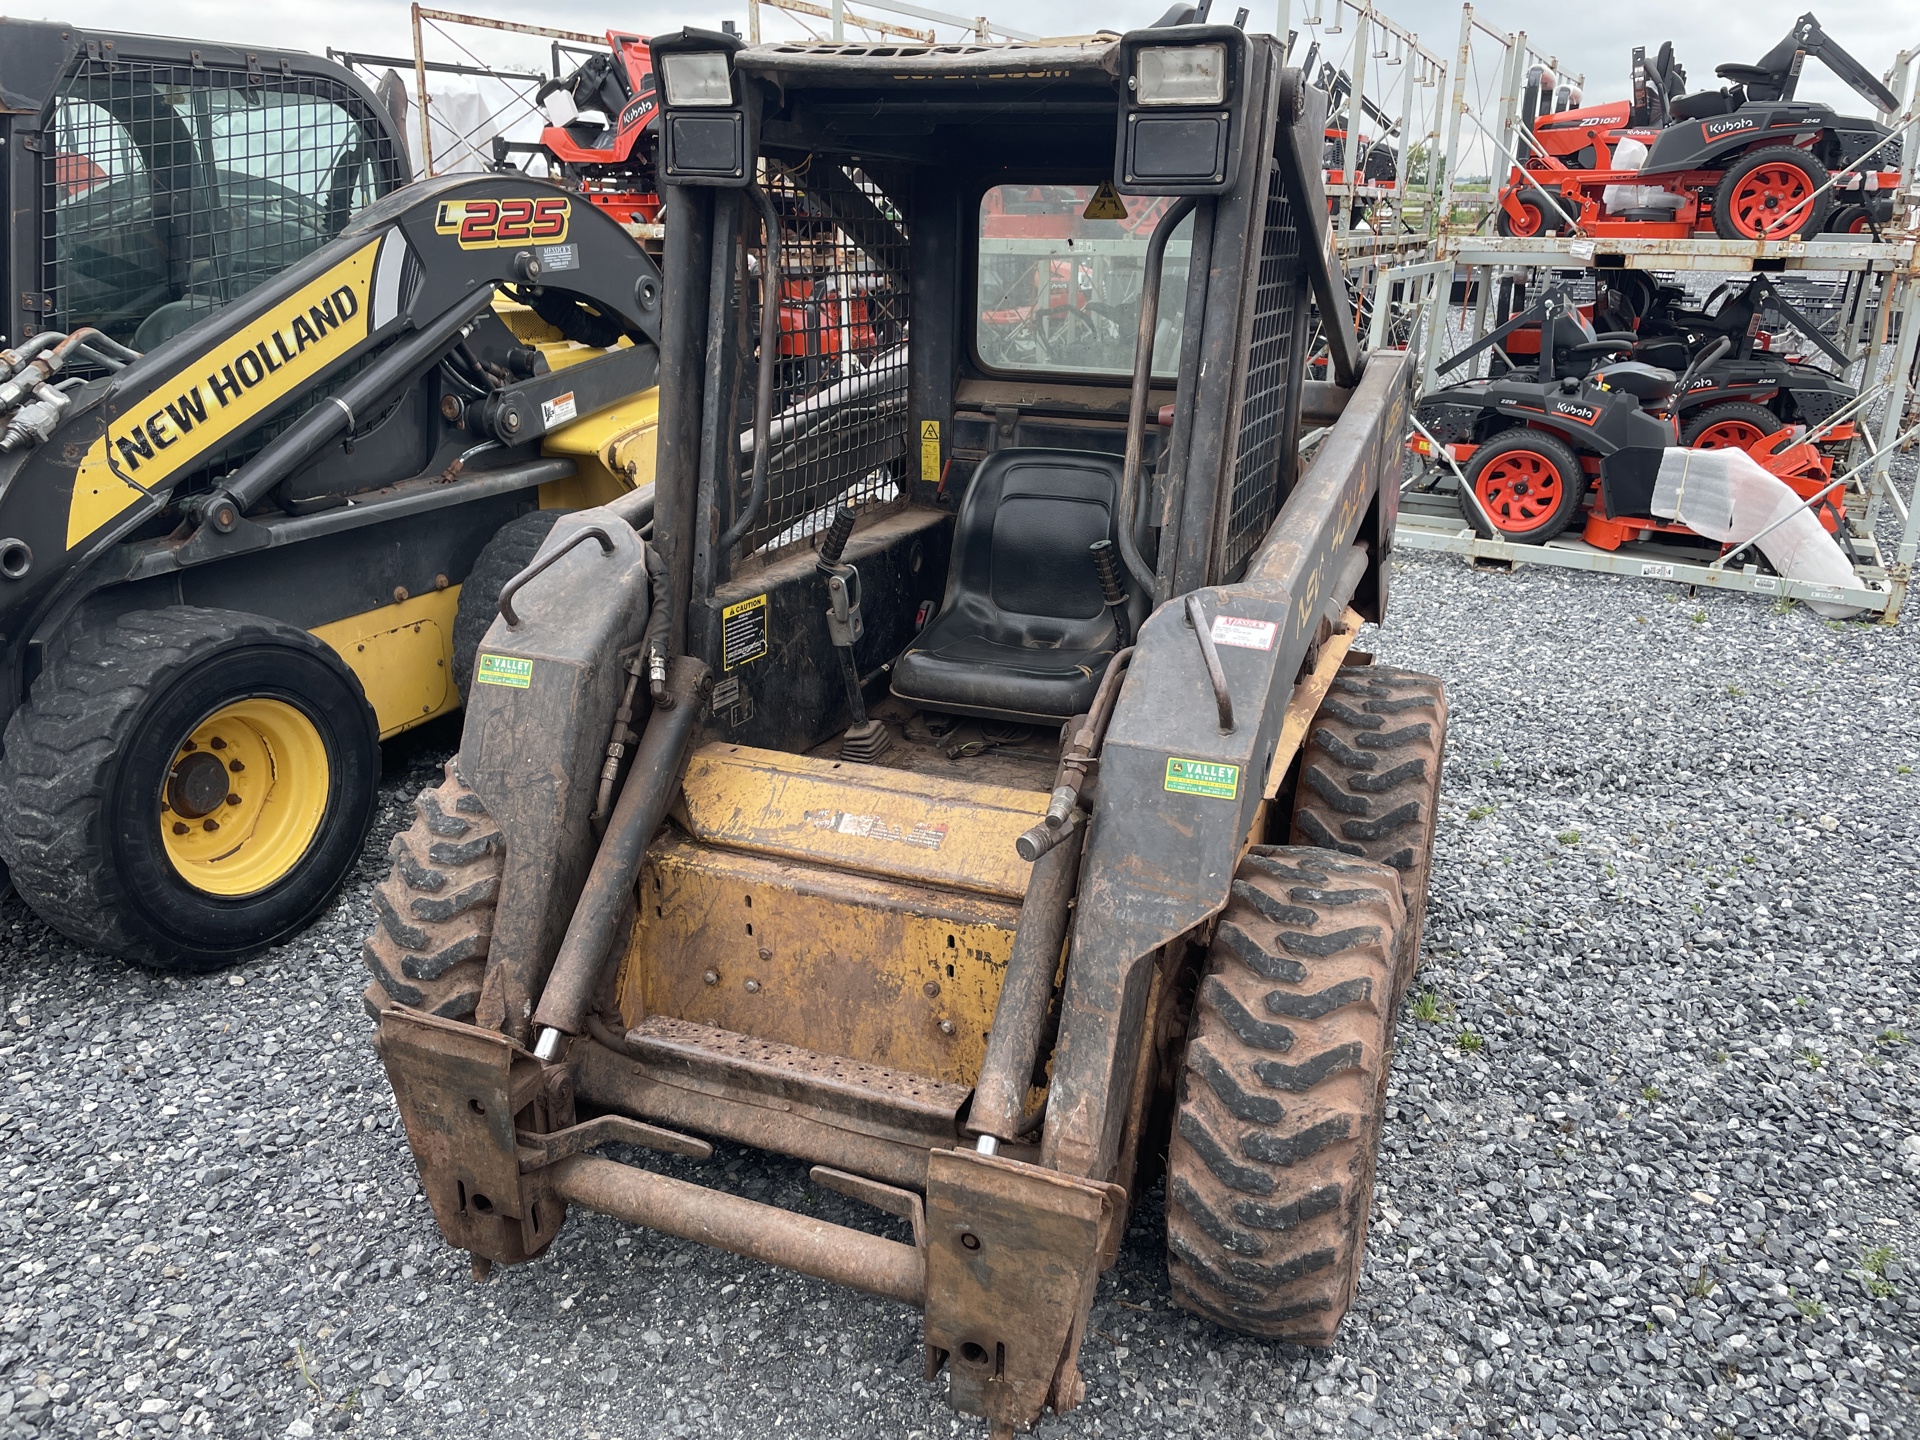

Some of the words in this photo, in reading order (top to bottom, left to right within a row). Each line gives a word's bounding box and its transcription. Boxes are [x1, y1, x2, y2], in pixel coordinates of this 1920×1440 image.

[623, 101, 652, 123] Kubota
[1710, 119, 1753, 133] Kubota
[114, 385, 208, 472] NEW
[207, 284, 359, 409] HOLLAND
[1556, 401, 1593, 418] Kubota
[735, 599, 762, 614] CAUTION
[495, 659, 530, 670] VALLEY
[1186, 762, 1234, 778] VALLEY
